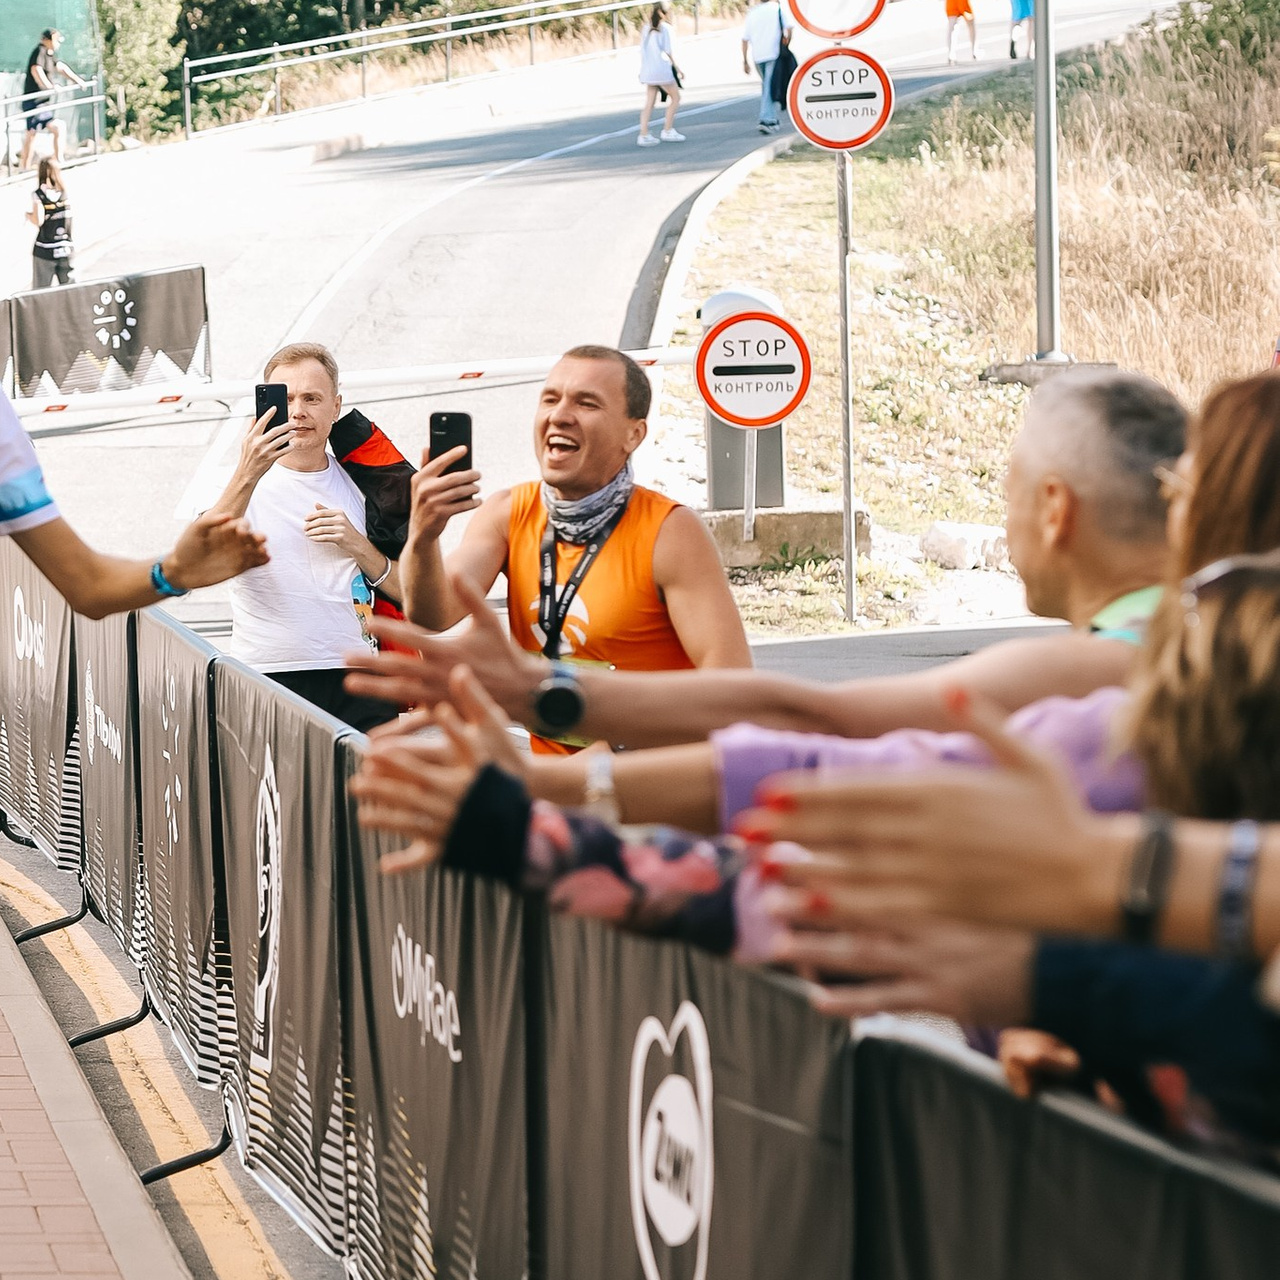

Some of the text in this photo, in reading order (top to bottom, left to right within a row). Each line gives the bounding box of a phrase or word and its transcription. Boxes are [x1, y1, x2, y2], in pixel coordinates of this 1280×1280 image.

[811, 68, 869, 87] STOP
[806, 107, 878, 121] КОНТРОЛЬ
[722, 338, 786, 357] STOP
[714, 380, 794, 393] КОНТРОЛЬ
